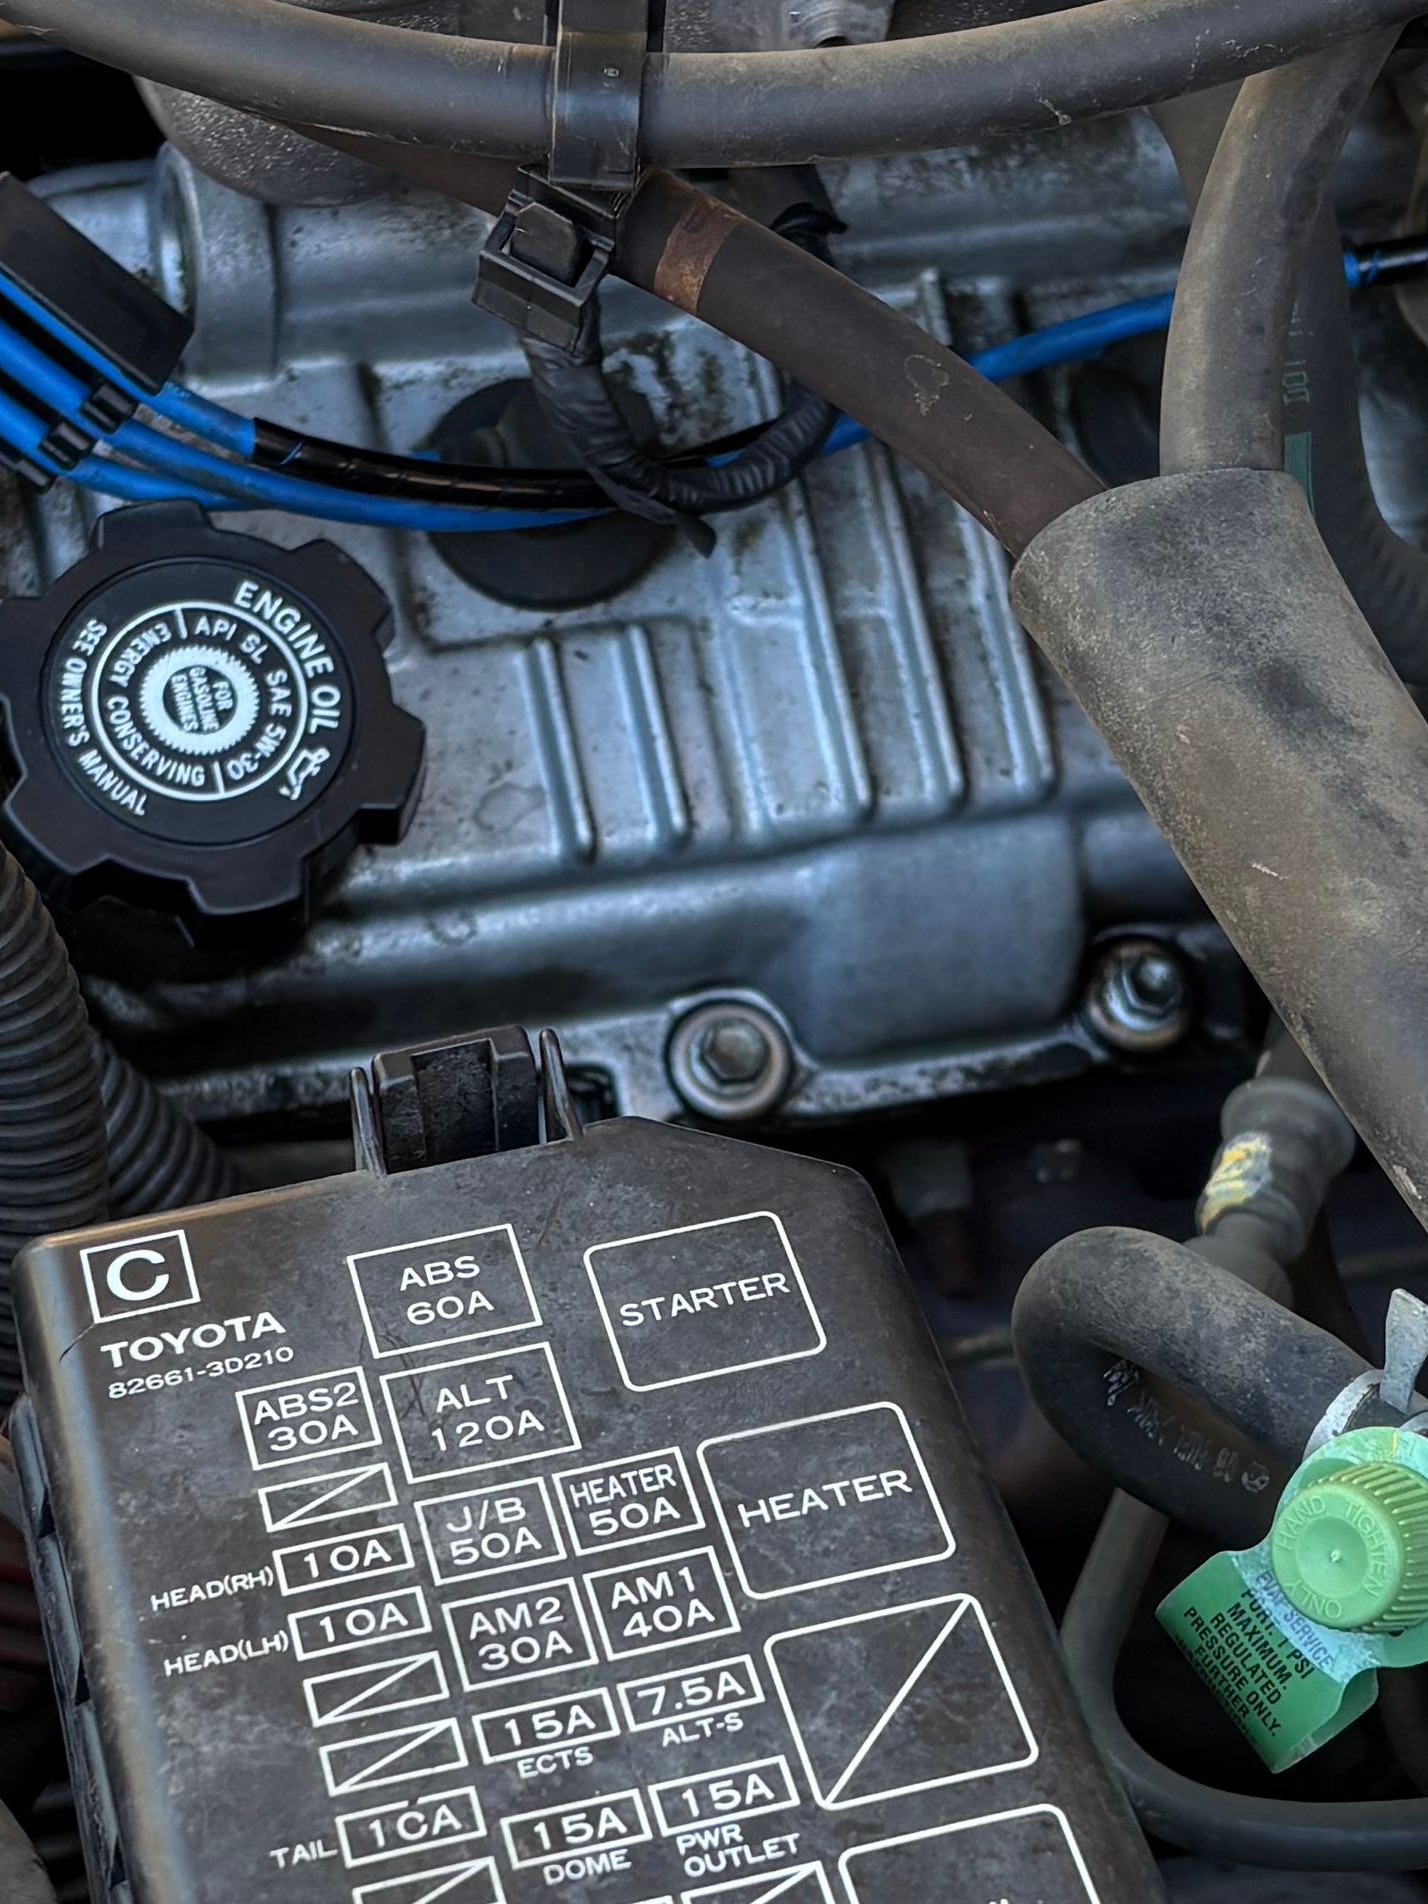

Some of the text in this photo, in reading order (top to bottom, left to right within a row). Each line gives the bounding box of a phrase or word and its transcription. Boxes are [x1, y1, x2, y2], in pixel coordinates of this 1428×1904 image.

[234, 579, 341, 735] ENGINE OIL
[60, 618, 149, 816] SEE OWNER'S MANUAL
[106, 622, 206, 787] ENERGY CONSERVING
[171, 673, 198, 733] ENGINES
[189, 667, 220, 732] GASOLINE
[194, 615, 293, 780] API SL SAE 5W-30
[213, 679, 235, 712] FOR
[106, 1249, 170, 1301] C
[399, 1255, 481, 1291] ABS
[406, 1291, 494, 1327] 60A
[619, 1272, 791, 1327] STARTER
[101, 1312, 287, 1368] TOYOTA
[109, 1346, 294, 1399] 82661-3D210
[435, 1374, 514, 1413] ALT
[253, 1381, 360, 1425] ABS2
[268, 1413, 359, 1454] 30A
[432, 1409, 545, 1453] 120A
[569, 1463, 677, 1508] HEATER
[737, 1469, 913, 1528] HEATER
[447, 1496, 527, 1534] J/B
[591, 1495, 681, 1536] 50A
[302, 1538, 392, 1579] 10A
[452, 1527, 542, 1566] 50A
[1274, 1494, 1392, 1620] HAND TIGHTEN ONLY
[151, 1565, 275, 1612] HEAD(RH)
[611, 1566, 695, 1609] AM1
[319, 1602, 409, 1642] 10A
[468, 1596, 566, 1641] AM2
[623, 1598, 716, 1638] 40A
[1284, 1604, 1335, 1671] SERVICE
[163, 1629, 290, 1676] HEAD(LH)
[479, 1631, 574, 1672] 30A
[1209, 1613, 1283, 1705] REGULATED
[1226, 1601, 1293, 1690] MAXIMUM.
[1290, 1641, 1315, 1680] PSI
[636, 1669, 746, 1716] 7.5A
[1183, 1606, 1250, 1692] PRESSURE
[1245, 1689, 1283, 1737] ONLY.
[1190, 1644, 1251, 1720] FURTHER
[504, 1704, 597, 1748] 15A
[661, 1712, 744, 1746] ALT-S
[517, 1746, 594, 1779] ECTS
[682, 1772, 775, 1818] 15A
[534, 1807, 627, 1851] 15A
[676, 1823, 744, 1855] PWR
[270, 1838, 338, 1869] TAIL
[543, 1850, 632, 1886] DOME
[684, 1833, 802, 1877] OUTLET
